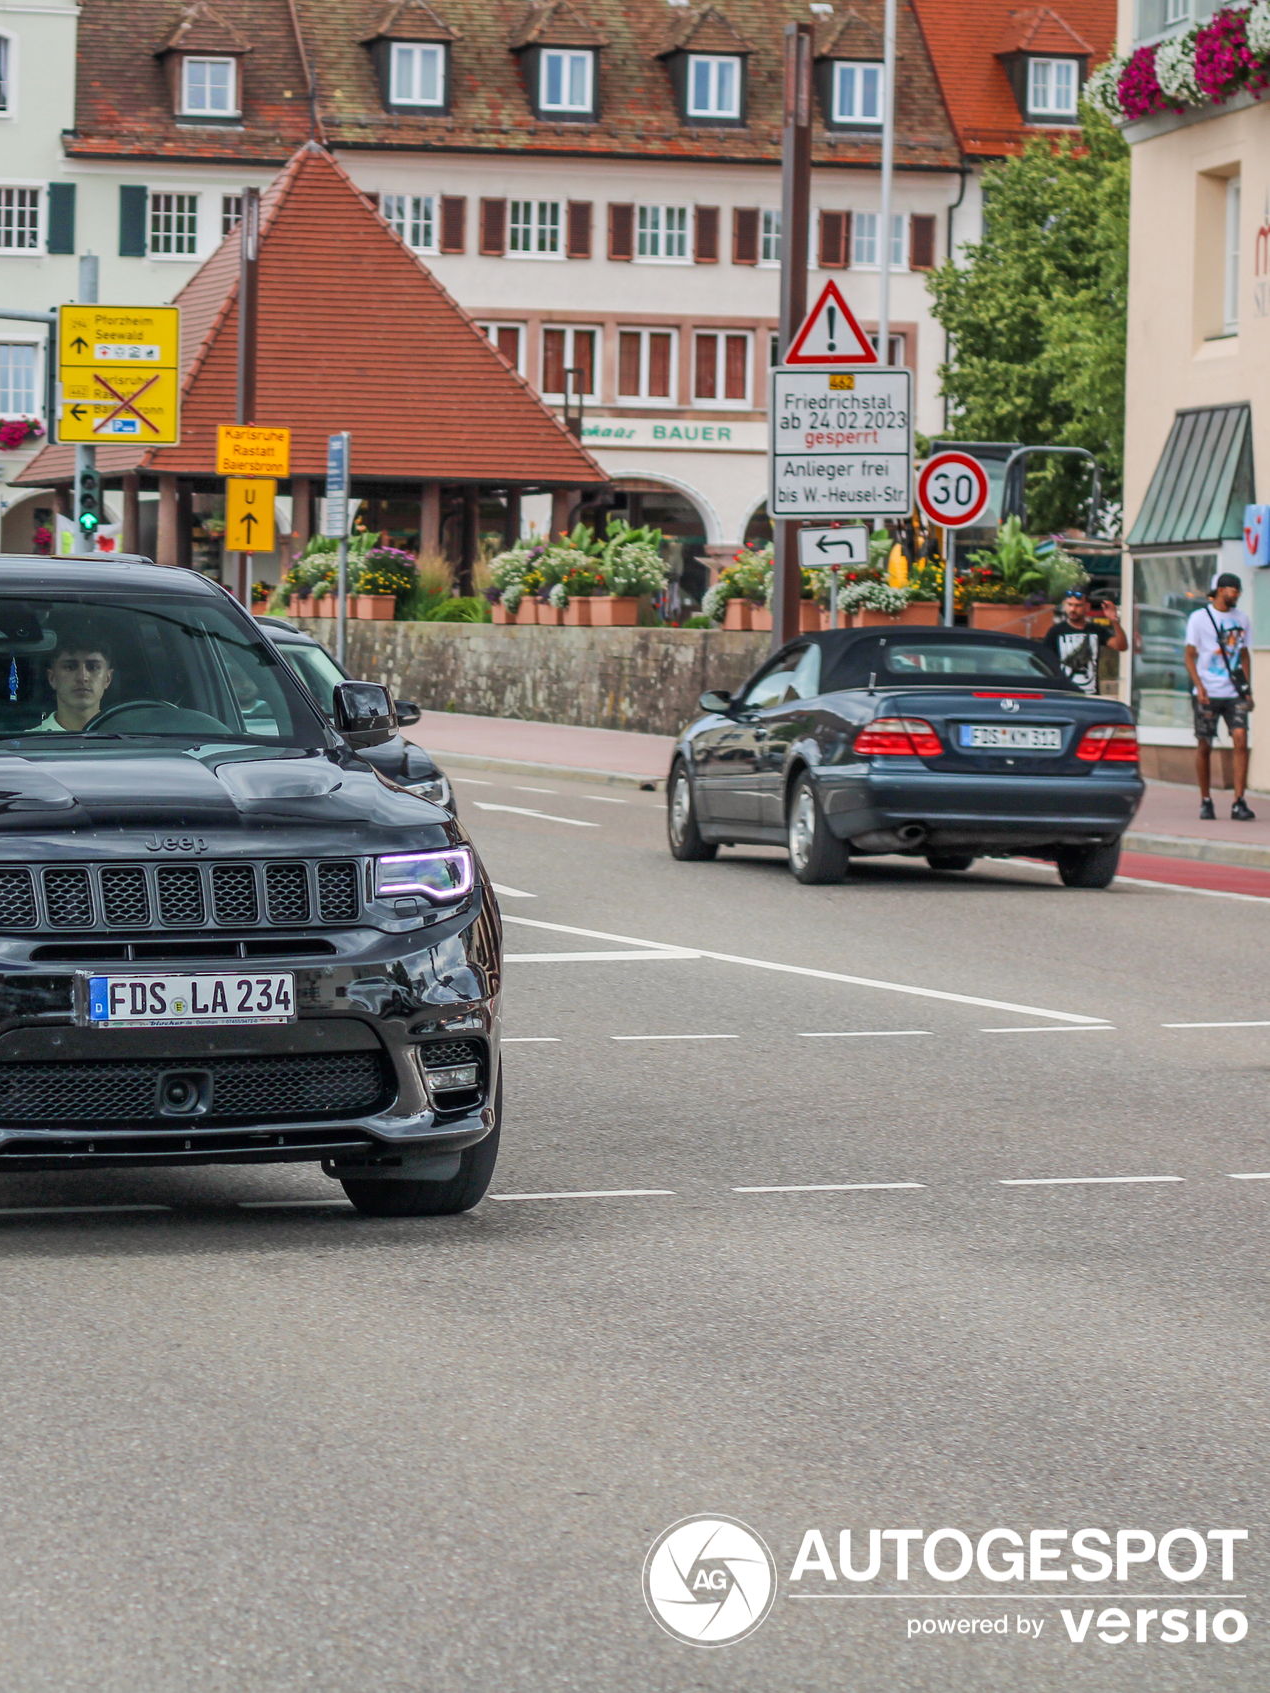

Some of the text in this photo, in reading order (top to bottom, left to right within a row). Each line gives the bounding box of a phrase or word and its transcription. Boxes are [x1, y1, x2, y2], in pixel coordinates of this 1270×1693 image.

[95, 314, 154, 326] Pforzheim
[95, 329, 144, 340] Seewald
[784, 393, 892, 409] Friedrichstal
[780, 411, 907, 429] ab 24.02.2023
[224, 428, 284, 441] Karlsruhe
[653, 425, 731, 441] BAUER
[805, 430, 878, 448] gesperrt
[233, 444, 275, 457] Rastatt
[223, 458, 283, 472] Baiersbronn
[784, 460, 890, 480] Anlieger frei
[244, 489, 256, 505] U
[778, 485, 906, 502] bis W.-Heusel-Str.
[933, 473, 972, 506] 30
[973, 728, 999, 744] FDS
[1032, 730, 1057, 746] 312
[145, 832, 209, 855] Jeep
[110, 979, 290, 1015] FDS LA 234
